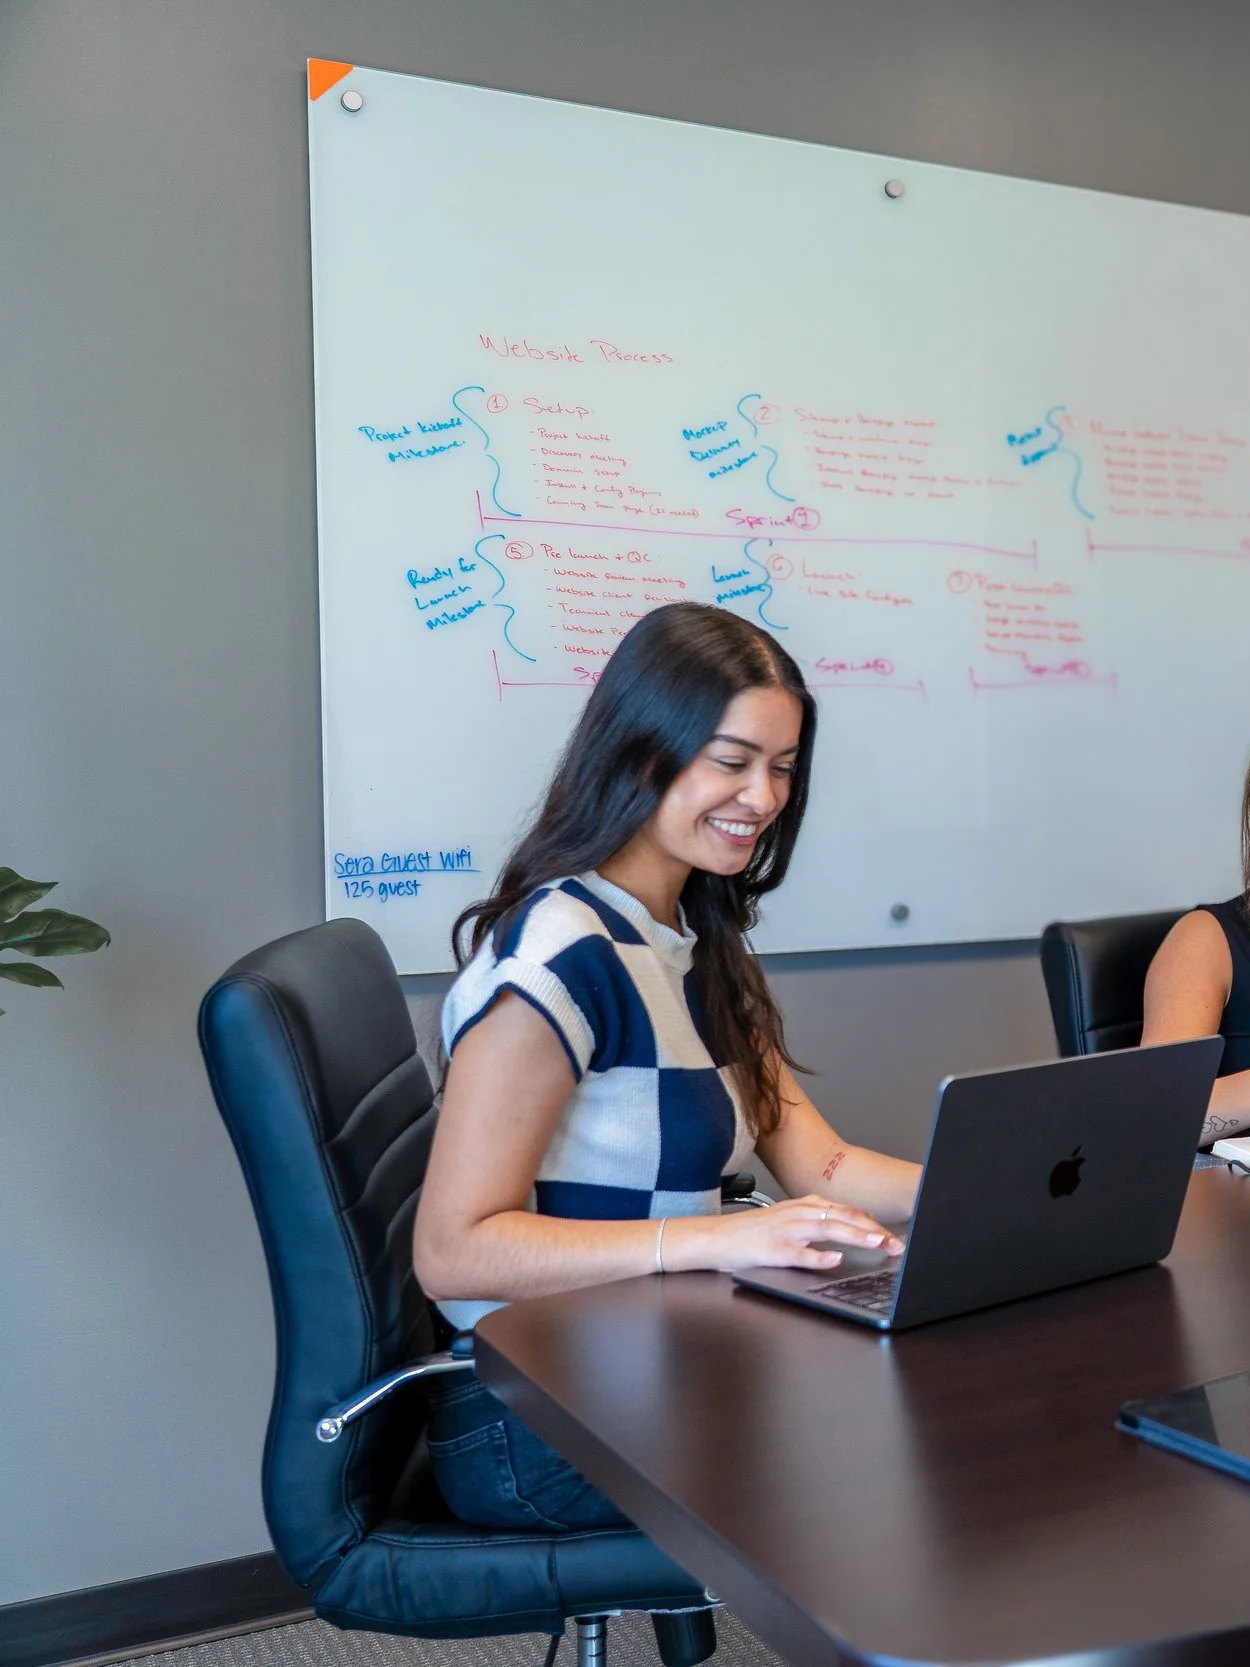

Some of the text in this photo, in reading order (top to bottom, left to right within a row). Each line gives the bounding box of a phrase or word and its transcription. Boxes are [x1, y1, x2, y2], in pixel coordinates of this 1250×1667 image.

[479, 334, 674, 363] Website Process
[358, 425, 412, 442] Project
[407, 567, 454, 590] Ready
[334, 852, 375, 876] Sera
[381, 851, 433, 873] Guest
[344, 879, 423, 904] 125 guest
